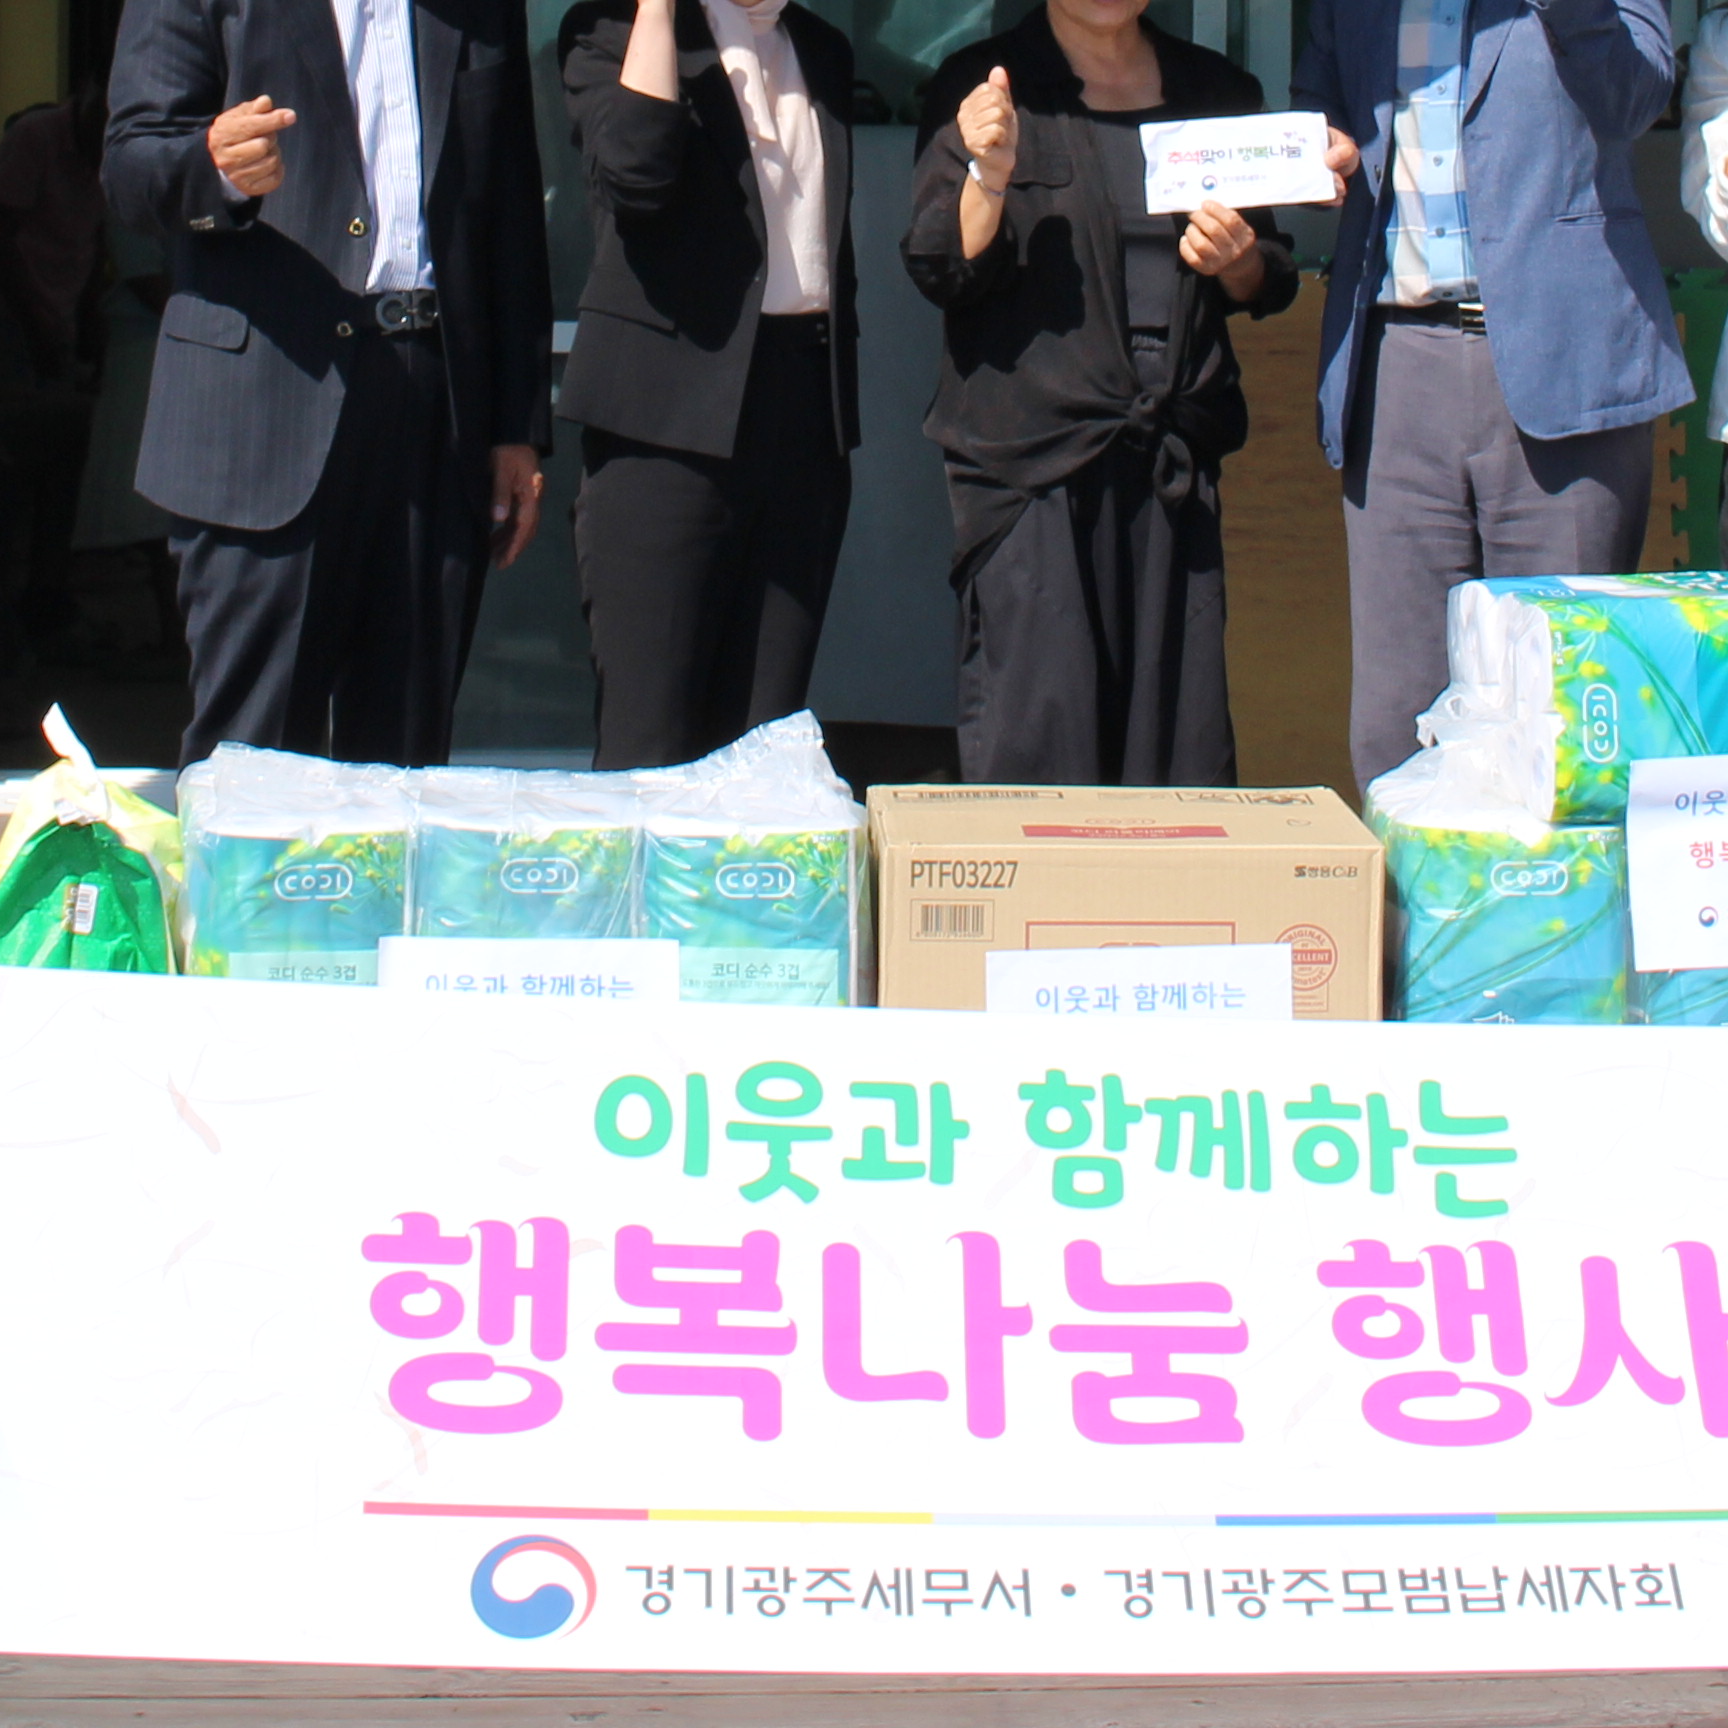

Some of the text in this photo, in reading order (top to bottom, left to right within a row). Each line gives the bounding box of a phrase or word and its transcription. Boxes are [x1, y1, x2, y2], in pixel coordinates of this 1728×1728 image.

[1168, 143, 1302, 165] 추석맞이 행복나눔
[910, 859, 1019, 889] PTF03227
[268, 965, 297, 981] 코디
[299, 965, 329, 981] 순수
[710, 962, 801, 981] 코디 순수 3겹
[1034, 981, 1248, 1014] 이웃과 함께하는
[592, 1060, 1519, 1218] 이웃과 함께하는
[360, 1211, 1249, 1446] 행복나눔
[623, 1560, 1686, 1621] 경기광주세무서 경기광주모범납세자회
